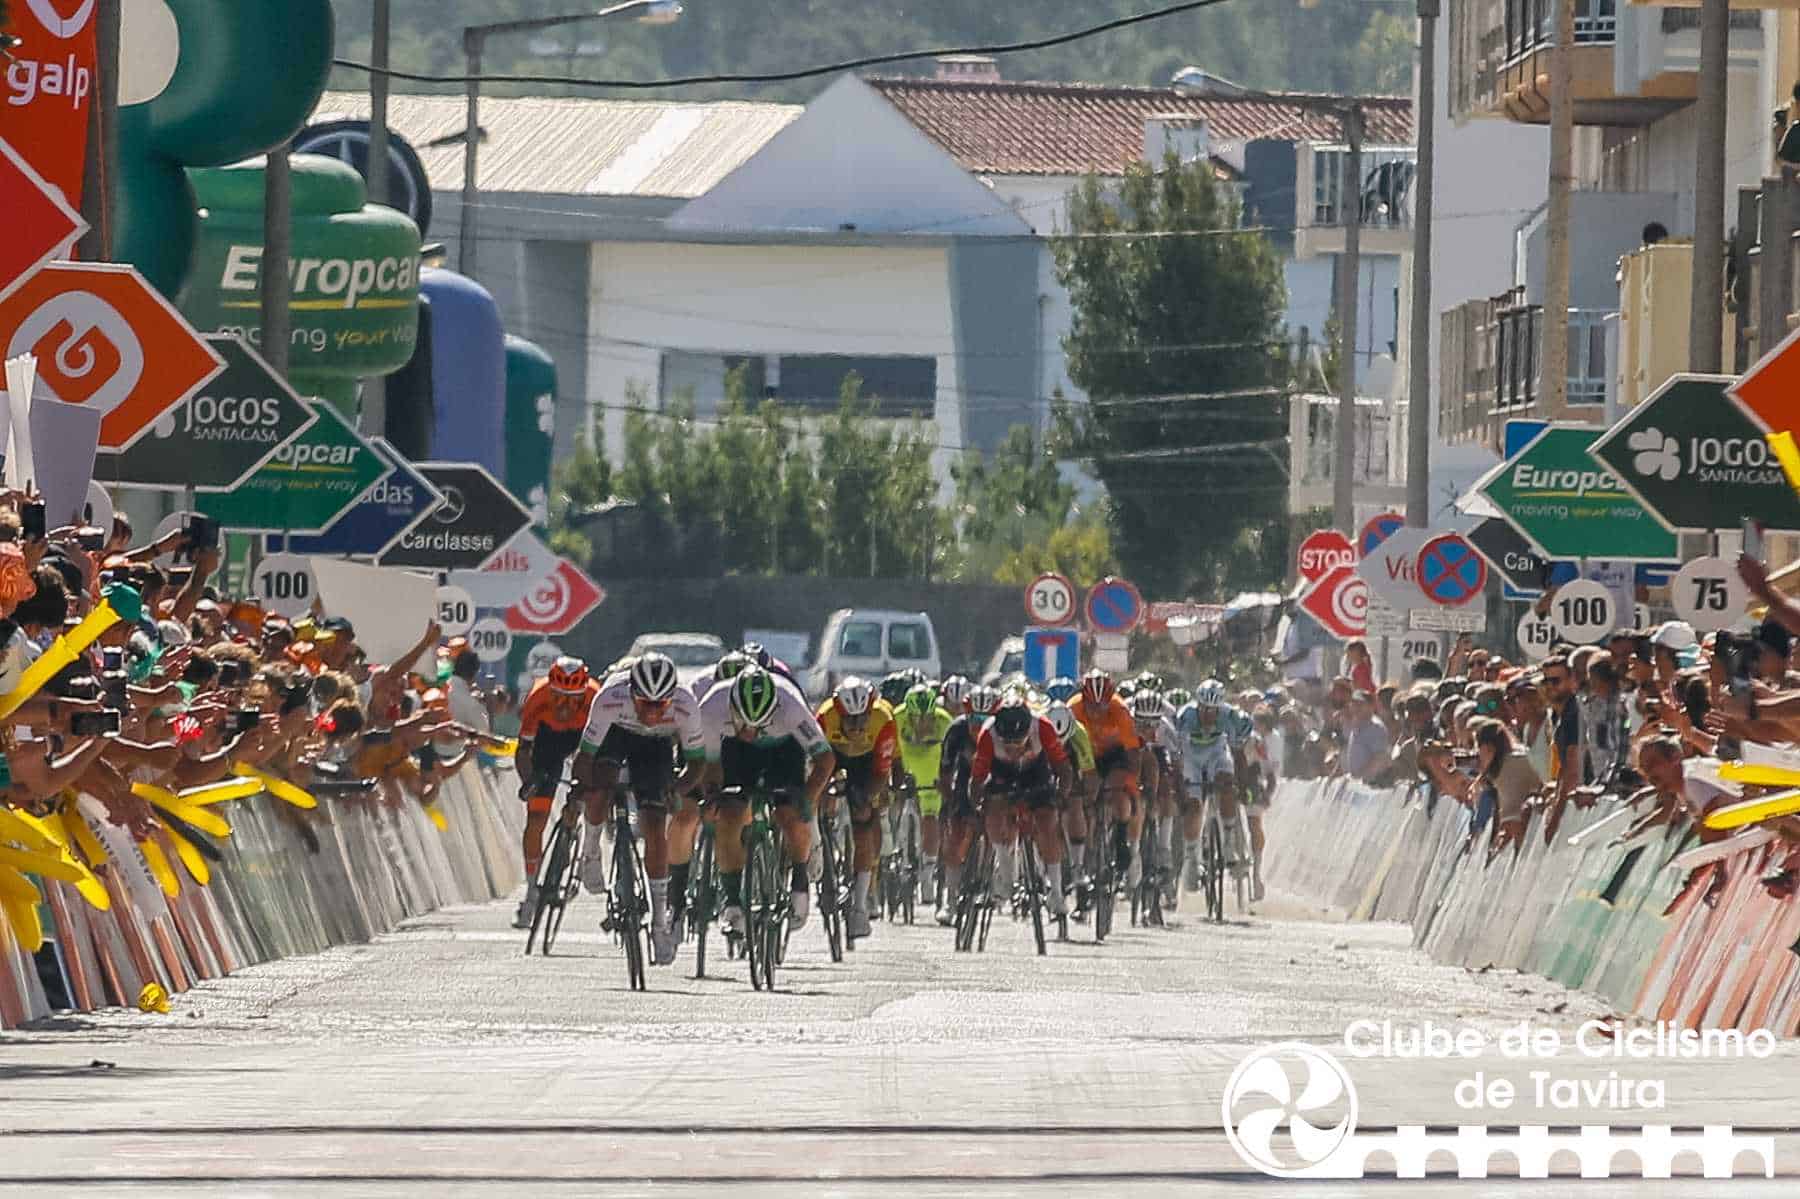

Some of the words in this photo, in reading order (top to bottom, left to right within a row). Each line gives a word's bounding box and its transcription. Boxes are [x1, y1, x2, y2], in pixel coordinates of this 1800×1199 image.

[7, 54, 89, 110] galp
[221, 245, 420, 308] Eropcar
[184, 397, 281, 432] JOGOS
[192, 427, 279, 442] SANTACASA
[275, 443, 360, 471] opcar
[1512, 464, 1626, 497] Europc
[1699, 468, 1785, 485] SANTACASA
[1511, 503, 1568, 520] moving
[400, 529, 494, 552] Carclasse
[1301, 551, 1354, 571] STOP
[261, 571, 309, 599] 100
[1692, 577, 1729, 611] 75
[1034, 589, 1067, 610] 30
[436, 602, 468, 624] 50
[1559, 597, 1607, 626] 100
[471, 631, 506, 649] 200
[1403, 640, 1438, 660] 200
